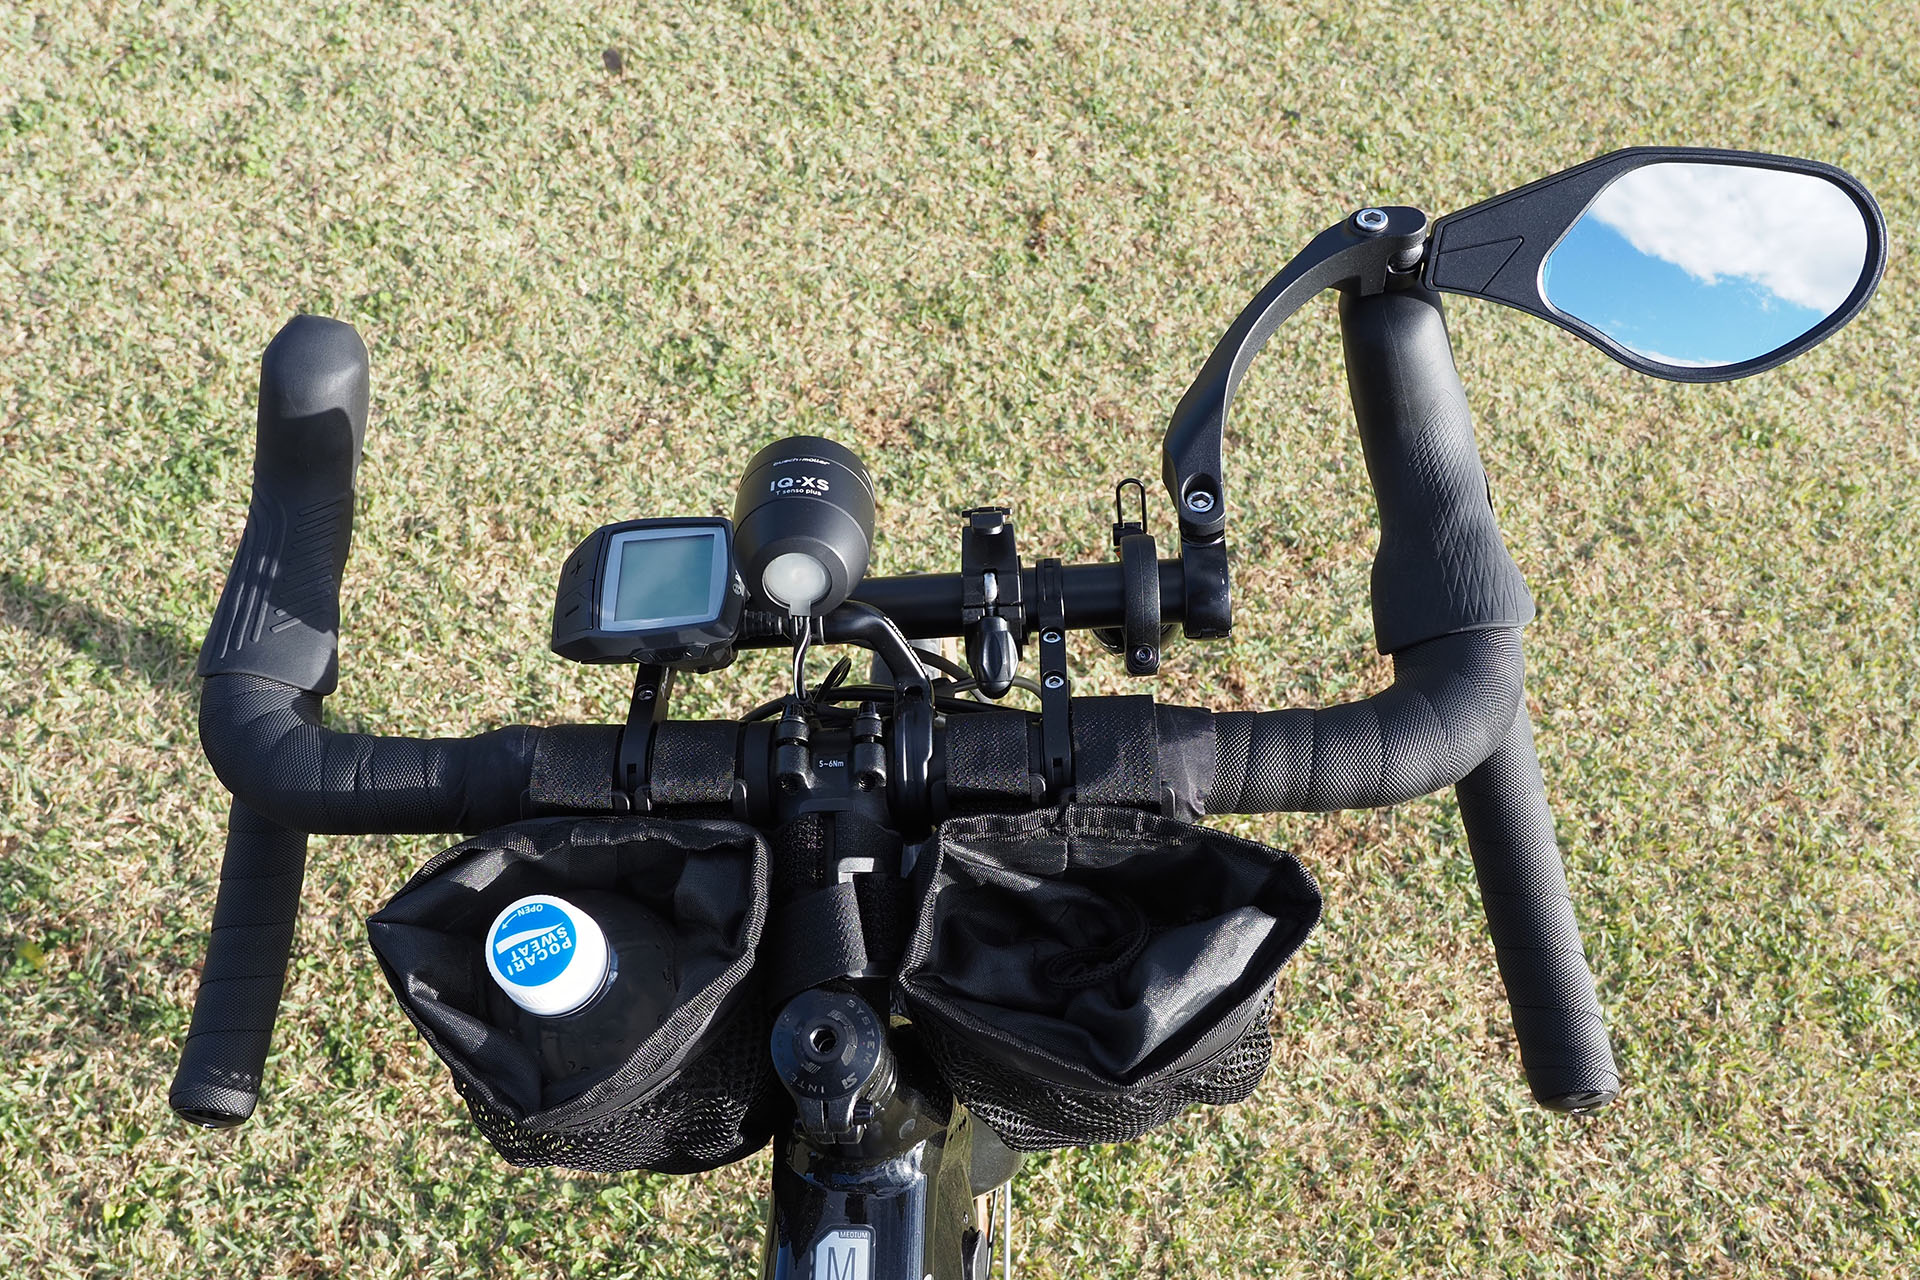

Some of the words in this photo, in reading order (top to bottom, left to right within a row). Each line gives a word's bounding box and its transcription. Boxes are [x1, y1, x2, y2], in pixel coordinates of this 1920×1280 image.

[770, 476, 830, 492] IQ-XS
[805, 488, 822, 496] plus
[517, 903, 544, 917] OPEN
[507, 936, 573, 977] POCARI
[511, 926, 568, 963] SWEAT
[846, 998, 876, 1064] SYSTEM
[839, 1231, 868, 1239] MEDIUM
[827, 1246, 856, 1280] M
